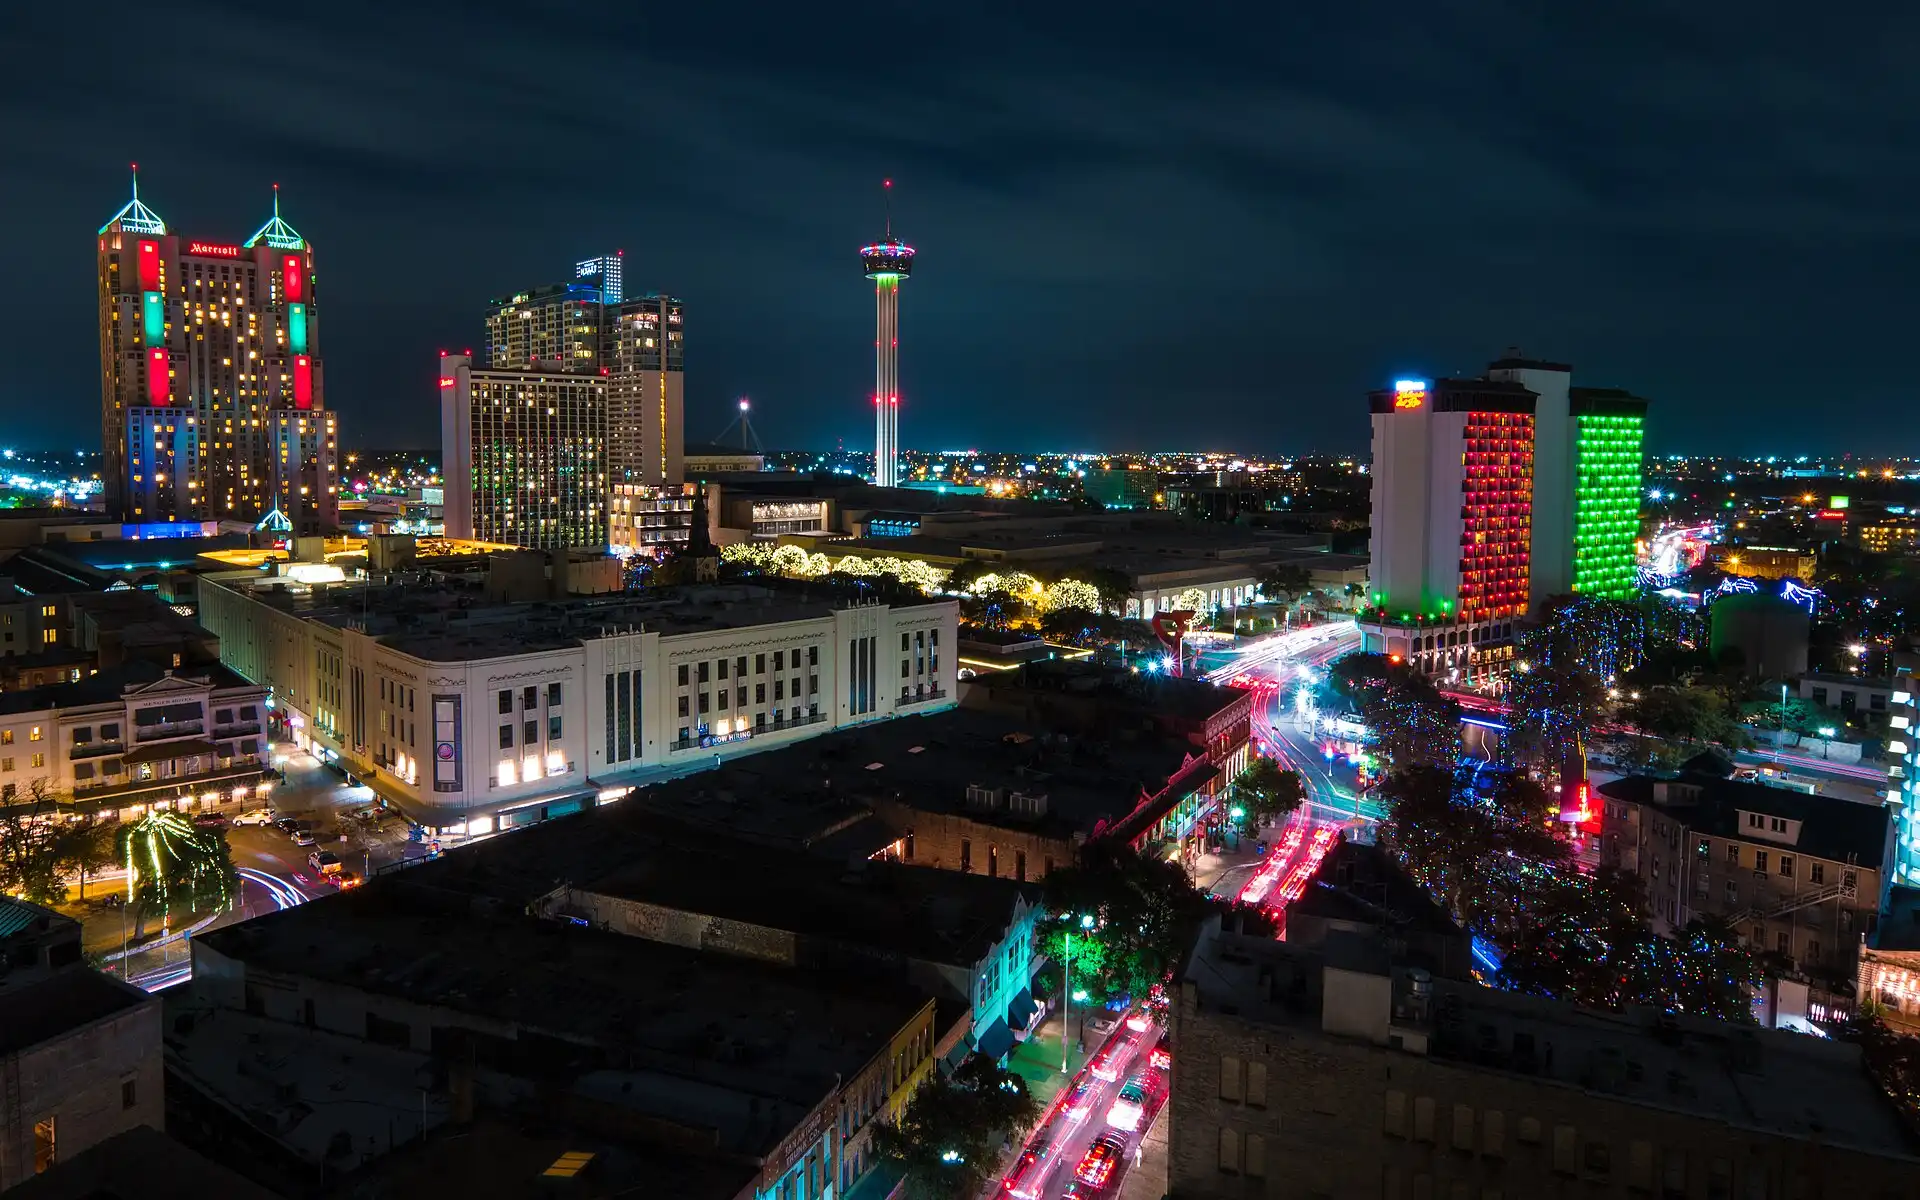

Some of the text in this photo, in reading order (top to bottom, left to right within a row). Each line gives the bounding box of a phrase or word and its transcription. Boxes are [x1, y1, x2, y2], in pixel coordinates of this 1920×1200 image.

[190, 243, 238, 256] Marriott
[712, 731, 752, 744] NOW HIRING
[786, 1141, 807, 1166] TRUNK
